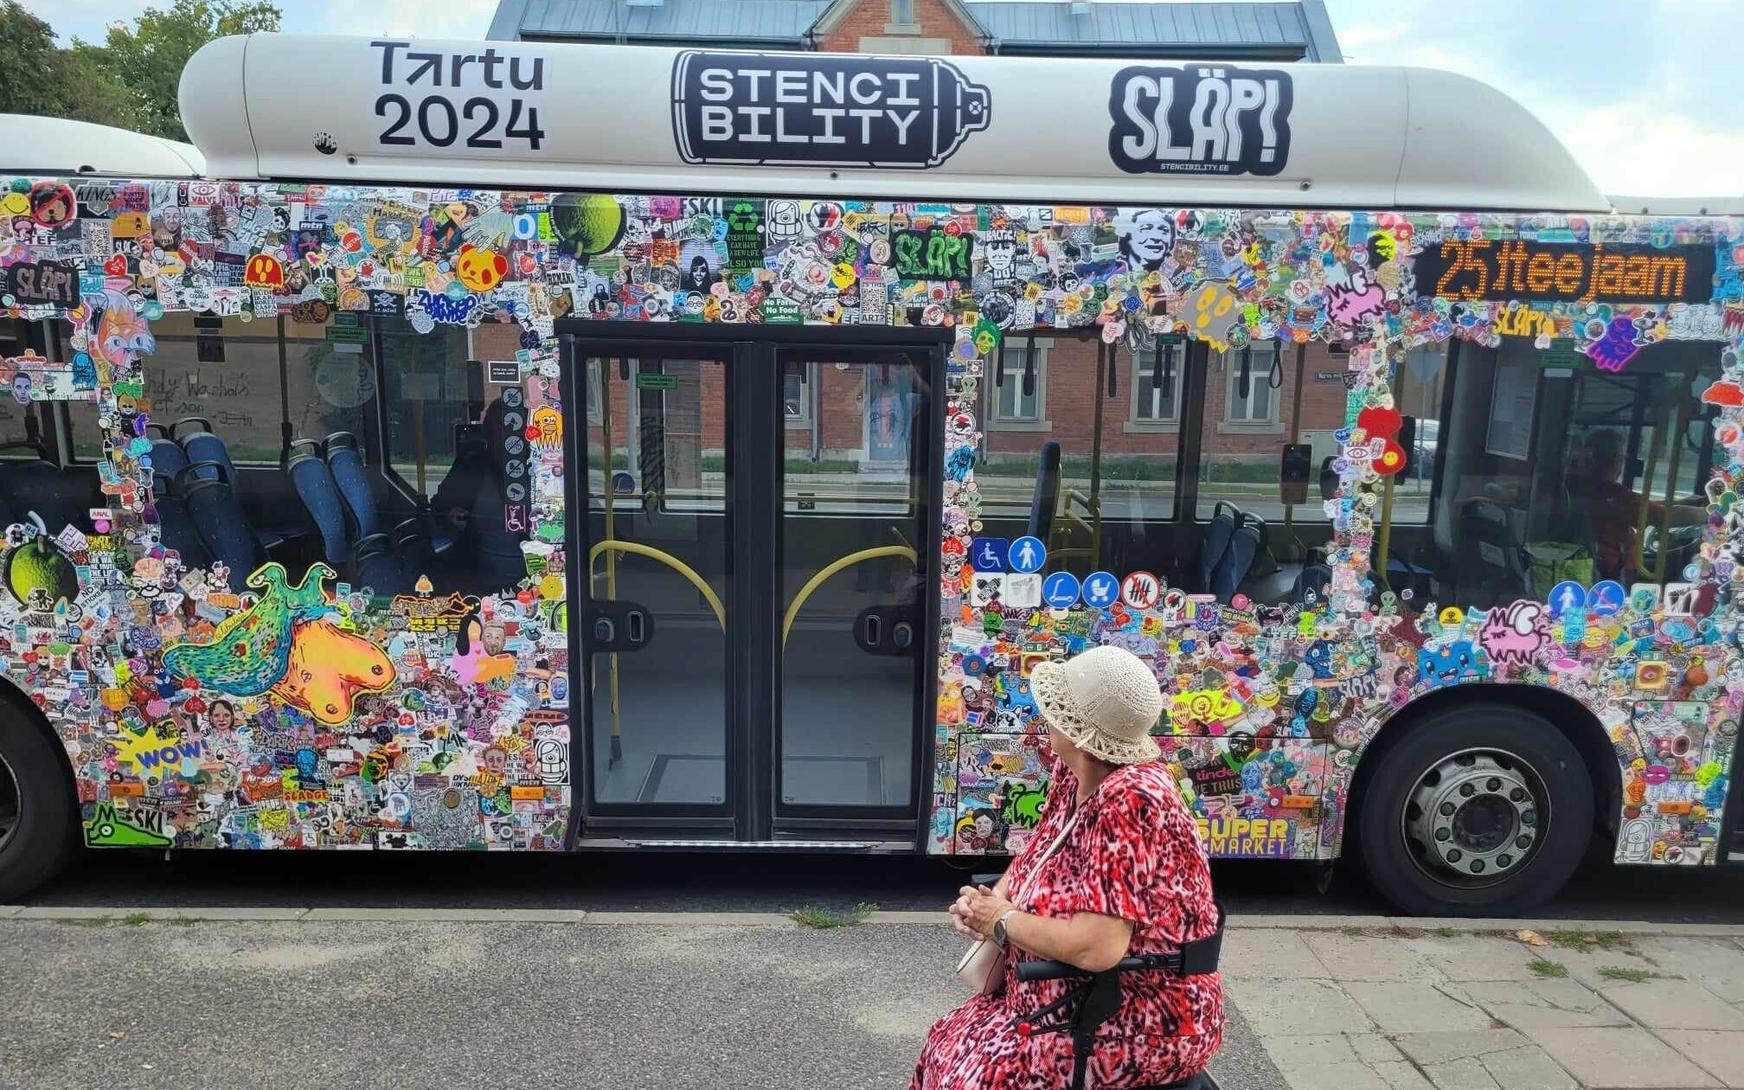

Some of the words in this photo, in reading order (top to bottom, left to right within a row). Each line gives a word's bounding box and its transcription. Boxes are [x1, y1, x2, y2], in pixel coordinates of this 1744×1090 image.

[700, 69, 920, 107] STENCI
[374, 93, 546, 151] 2024
[701, 106, 920, 145] BILITY
[1122, 68, 1280, 163] SLÄP!
[1160, 162, 1230, 172] STENCIBILITY.EE
[16, 266, 72, 302] SLÄP!
[1436, 239, 1493, 302] 25
[766, 306, 777, 314] No
[779, 306, 798, 314] Food
[136, 740, 209, 769] WOW!
[1195, 767, 1237, 781] tinde
[1197, 818, 1289, 840] SUPER
[1210, 838, 1287, 855] MARKET
